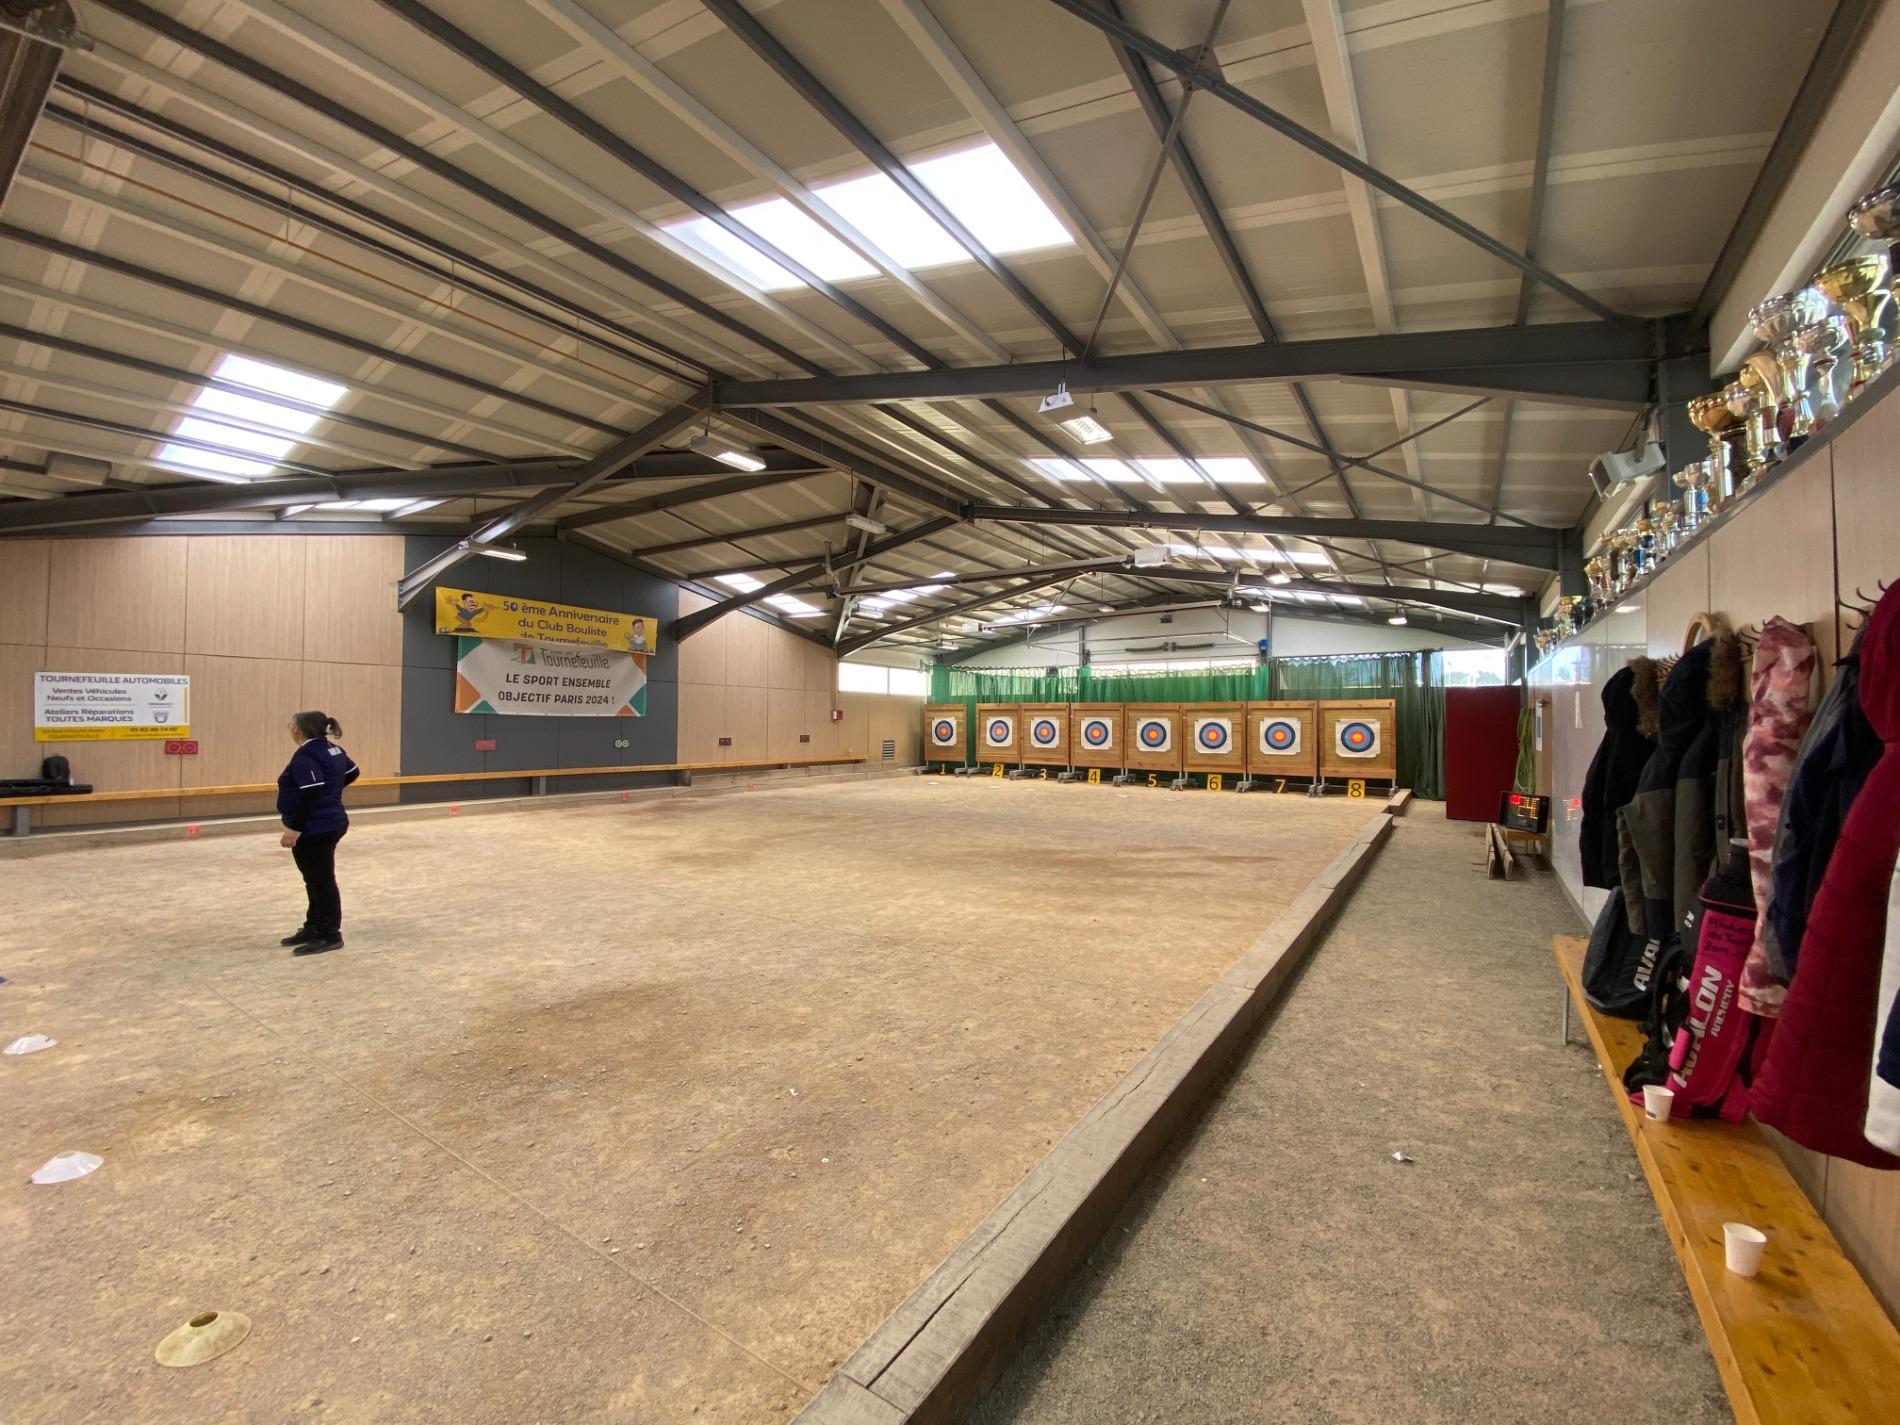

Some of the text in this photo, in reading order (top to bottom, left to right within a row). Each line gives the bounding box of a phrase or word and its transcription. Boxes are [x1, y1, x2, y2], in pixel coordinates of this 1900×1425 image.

[502, 600, 620, 626] 50 ème Anniversaire
[518, 618, 608, 637] du Club Bouliste
[540, 648, 610, 668] Tournefeuille
[40, 675, 188, 685] TOURNEFEUILLE AUTOMOBILES
[506, 672, 611, 688] LE SPORT ENSEMBLE
[85, 687, 127, 695] Véhicules
[498, 691, 552, 703] OBJECTIF
[554, 694, 583, 704] PARIS
[585, 695, 609, 704] 2024
[81, 708, 134, 716] Réparations
[940, 763, 946, 775] 1
[994, 764, 1001, 776] 2
[1039, 768, 1047, 781] 3
[1089, 770, 1097, 782] 4
[1148, 773, 1157, 787] 5
[1210, 776, 1218, 790] 6
[1276, 779, 1286, 793] 7
[1351, 783, 1362, 797] 8
